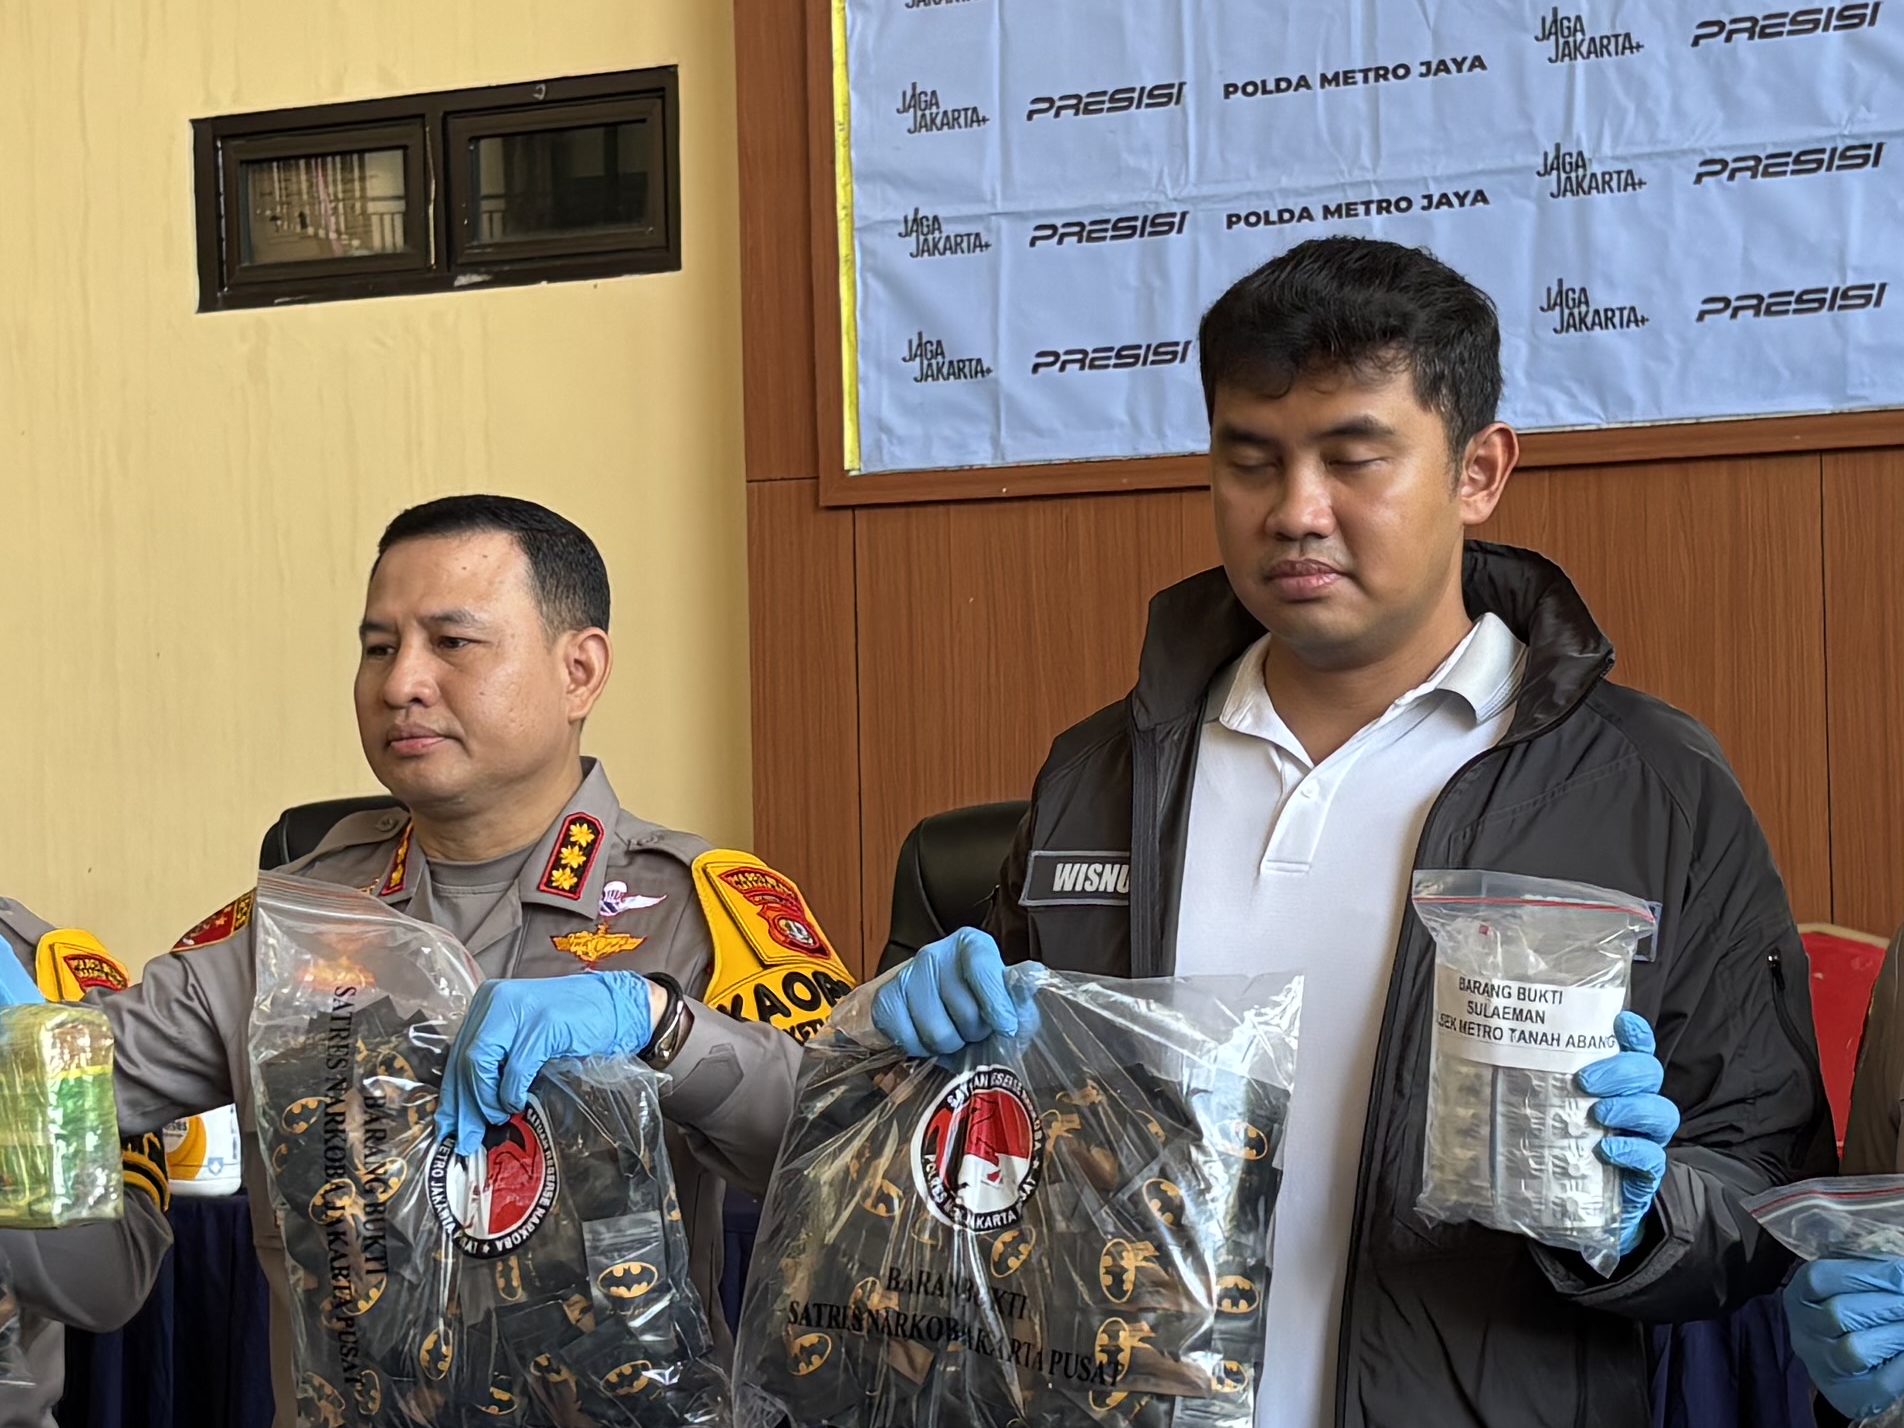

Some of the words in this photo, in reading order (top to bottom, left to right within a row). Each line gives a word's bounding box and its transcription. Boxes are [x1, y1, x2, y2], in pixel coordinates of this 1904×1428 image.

[1536, 143, 1587, 178] JAGA
[1694, 142, 1885, 184] PRESISI
[898, 208, 941, 239] JAGA
[1227, 207, 1314, 229] POLDA
[1323, 196, 1413, 220] METRO
[1421, 189, 1489, 211] JAYA
[1030, 211, 1189, 247] PRESISI
[1053, 863, 1130, 893] WISNU
[1459, 976, 1512, 999] BARANG
[1517, 987, 1563, 1005] BUKTI
[325, 985, 358, 1070] SATRES
[1467, 1001, 1545, 1024] SULAEMAN
[1459, 1020, 1503, 1041] METRO
[1510, 1028, 1560, 1047] TANAH
[1566, 1034, 1616, 1048] ABANG
[363, 1096, 389, 1195] BARANG
[431, 1137, 455, 1178] METRO
[429, 1181, 456, 1235] JAKARTA
[363, 1200, 390, 1275] BUKTI
[496, 1210, 546, 1252] NARKOBA
[1049, 1348, 1125, 1387] PUSAT
